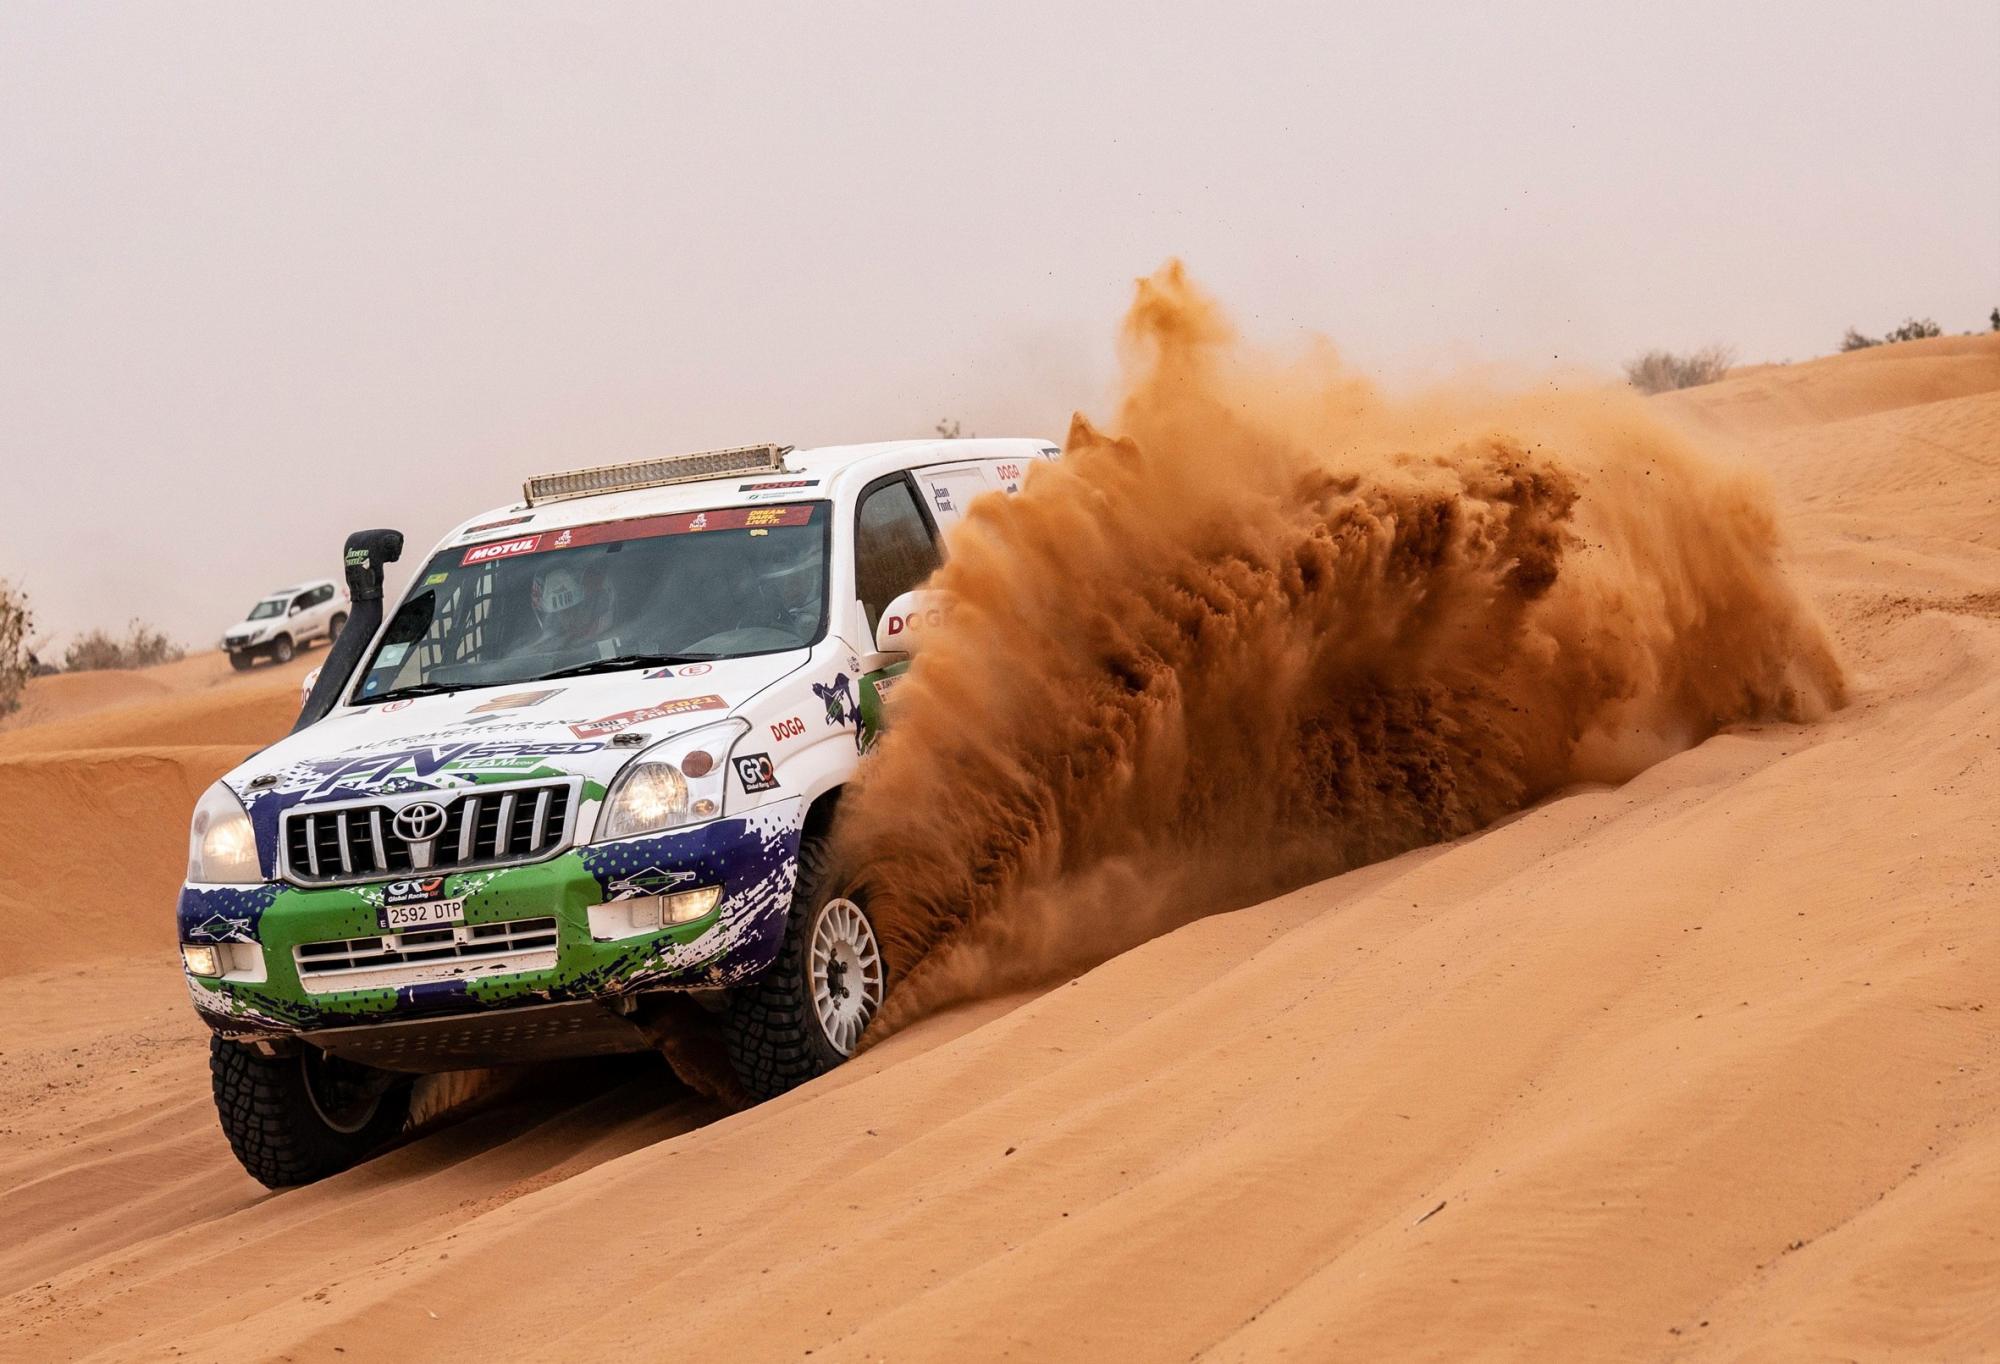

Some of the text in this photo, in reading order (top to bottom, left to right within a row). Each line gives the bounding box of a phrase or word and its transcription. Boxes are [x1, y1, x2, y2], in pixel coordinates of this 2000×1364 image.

[996, 464, 1020, 480] DOGA
[468, 540, 534, 560] MOTUL
[770, 717, 806, 742] DOGA
[459, 742, 605, 759] SPEED
[388, 894, 408, 903] Global
[380, 902, 461, 928] E 2592 DTP
